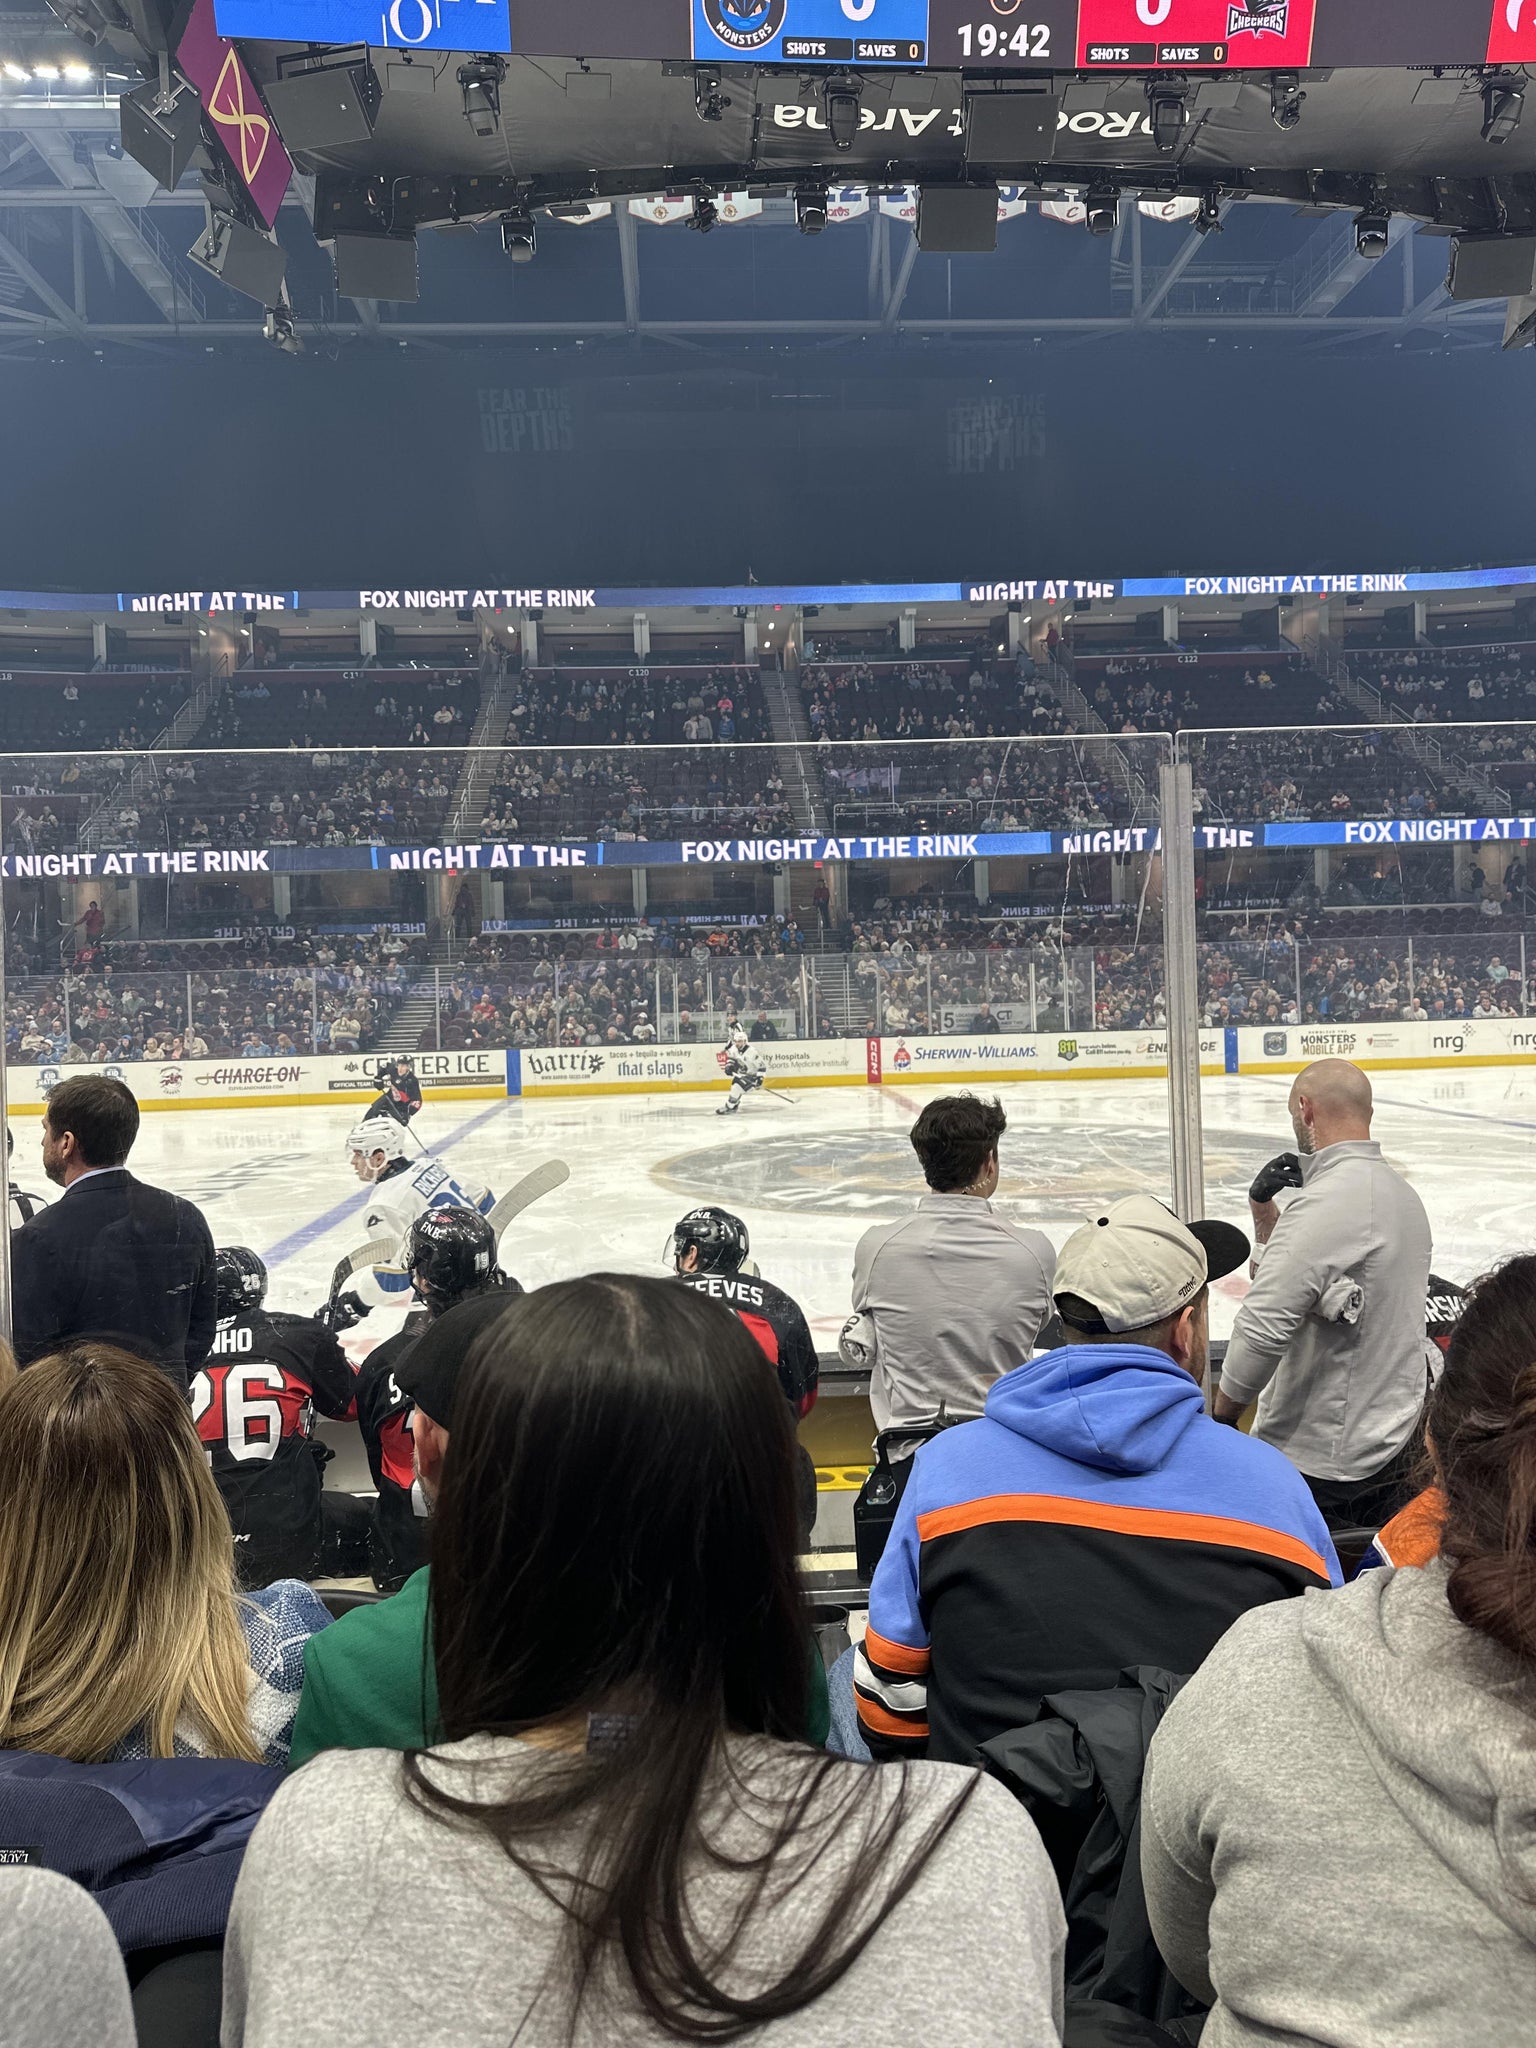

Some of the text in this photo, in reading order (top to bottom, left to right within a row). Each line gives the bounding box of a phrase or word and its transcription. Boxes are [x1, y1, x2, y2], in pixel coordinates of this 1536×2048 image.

[1229, 8, 1286, 32] CHECKERS
[715, 20, 773, 46] MONSTERS
[957, 22, 1050, 57] 19:42
[786, 42, 826, 56] SHOTS
[858, 44, 918, 58] SAVES 0
[1090, 47, 1129, 60] SHOTS
[1162, 47, 1223, 60] SAVES 0
[969, 580, 1115, 601] NIGHT AT THE
[1185, 573, 1408, 595] FOX NIGHT AT THE RINK
[132, 591, 285, 612] NIGHT AT THE
[359, 589, 596, 608] FOX NIGHT AT THE RINK
[1062, 827, 1148, 854] NIGHT
[1202, 826, 1254, 848] THE
[1345, 821, 1393, 843] FOX
[1400, 819, 1477, 842] NIGHT
[1481, 818, 1515, 840] AT
[390, 844, 587, 870] NIGHT AT THE
[681, 834, 979, 862] FOX NIGHT AT THE RINK
[15, 854, 97, 877] NIGHT
[102, 853, 138, 875] AT
[142, 851, 198, 873] THE
[203, 849, 270, 872] RINK
[1058, 1040, 1077, 1054] 811
[1300, 1033, 1357, 1045] MONSTERS
[1302, 1043, 1355, 1055] MOBILE APP
[1433, 1035, 1464, 1053] nrg
[609, 1051, 628, 1059] tacos
[635, 1050, 658, 1059] tequila
[666, 1049, 692, 1058] whiskey
[775, 1052, 810, 1061] Hospitals
[870, 1040, 879, 1076] CCM
[914, 1045, 1037, 1060] SHERWIN-WILLIAMS
[457, 1054, 490, 1074] ICE
[618, 1059, 684, 1079] that slaps
[768, 1059, 849, 1069] Sports Medicine Institute
